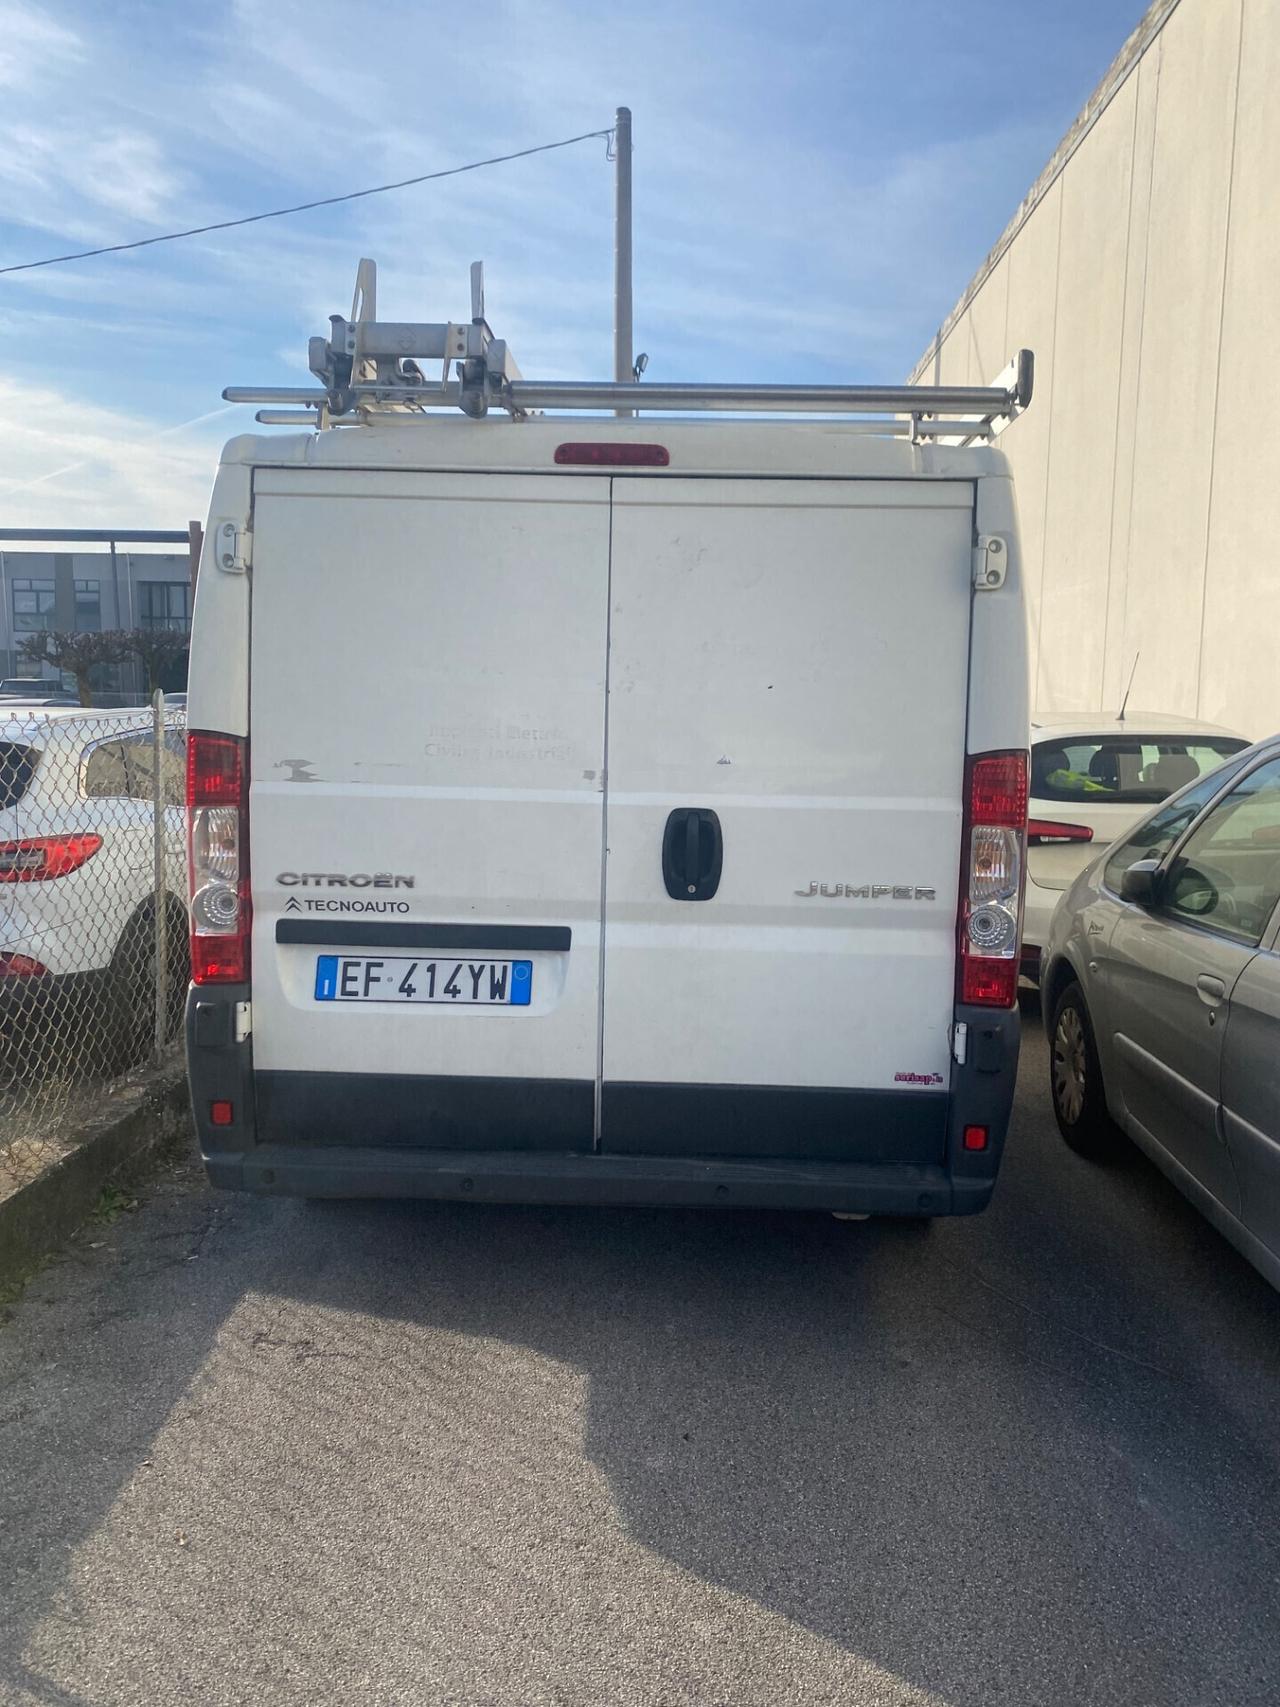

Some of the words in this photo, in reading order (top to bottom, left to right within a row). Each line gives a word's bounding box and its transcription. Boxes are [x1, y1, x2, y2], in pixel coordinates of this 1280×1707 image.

[276, 872, 416, 889] CITROËN
[794, 880, 937, 901] JUMPER
[304, 900, 410, 914] TECNOAUTO
[340, 961, 384, 997] EF
[398, 963, 508, 1000] 414YW
